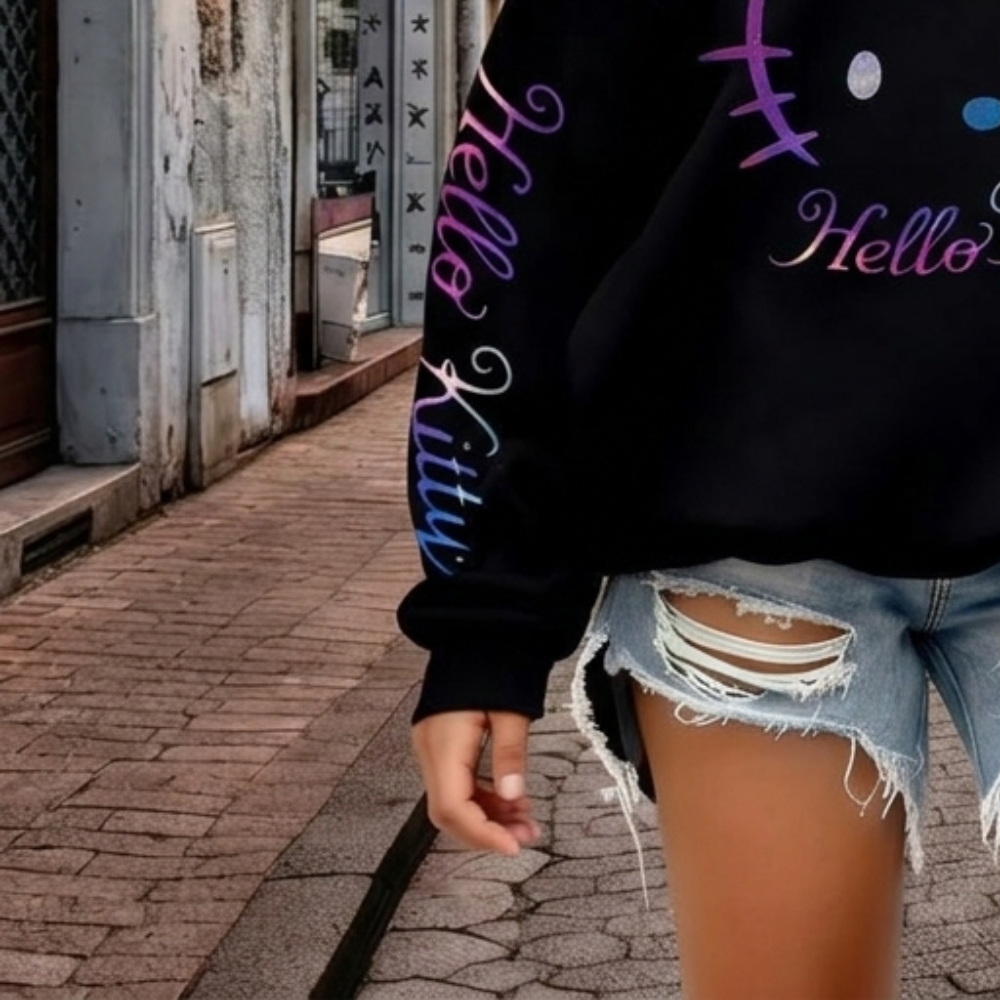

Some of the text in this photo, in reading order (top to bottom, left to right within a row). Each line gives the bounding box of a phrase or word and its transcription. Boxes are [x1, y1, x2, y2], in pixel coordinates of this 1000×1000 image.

[413, 66, 565, 576] Hello Kitty
[769, 188, 993, 276] Hello
